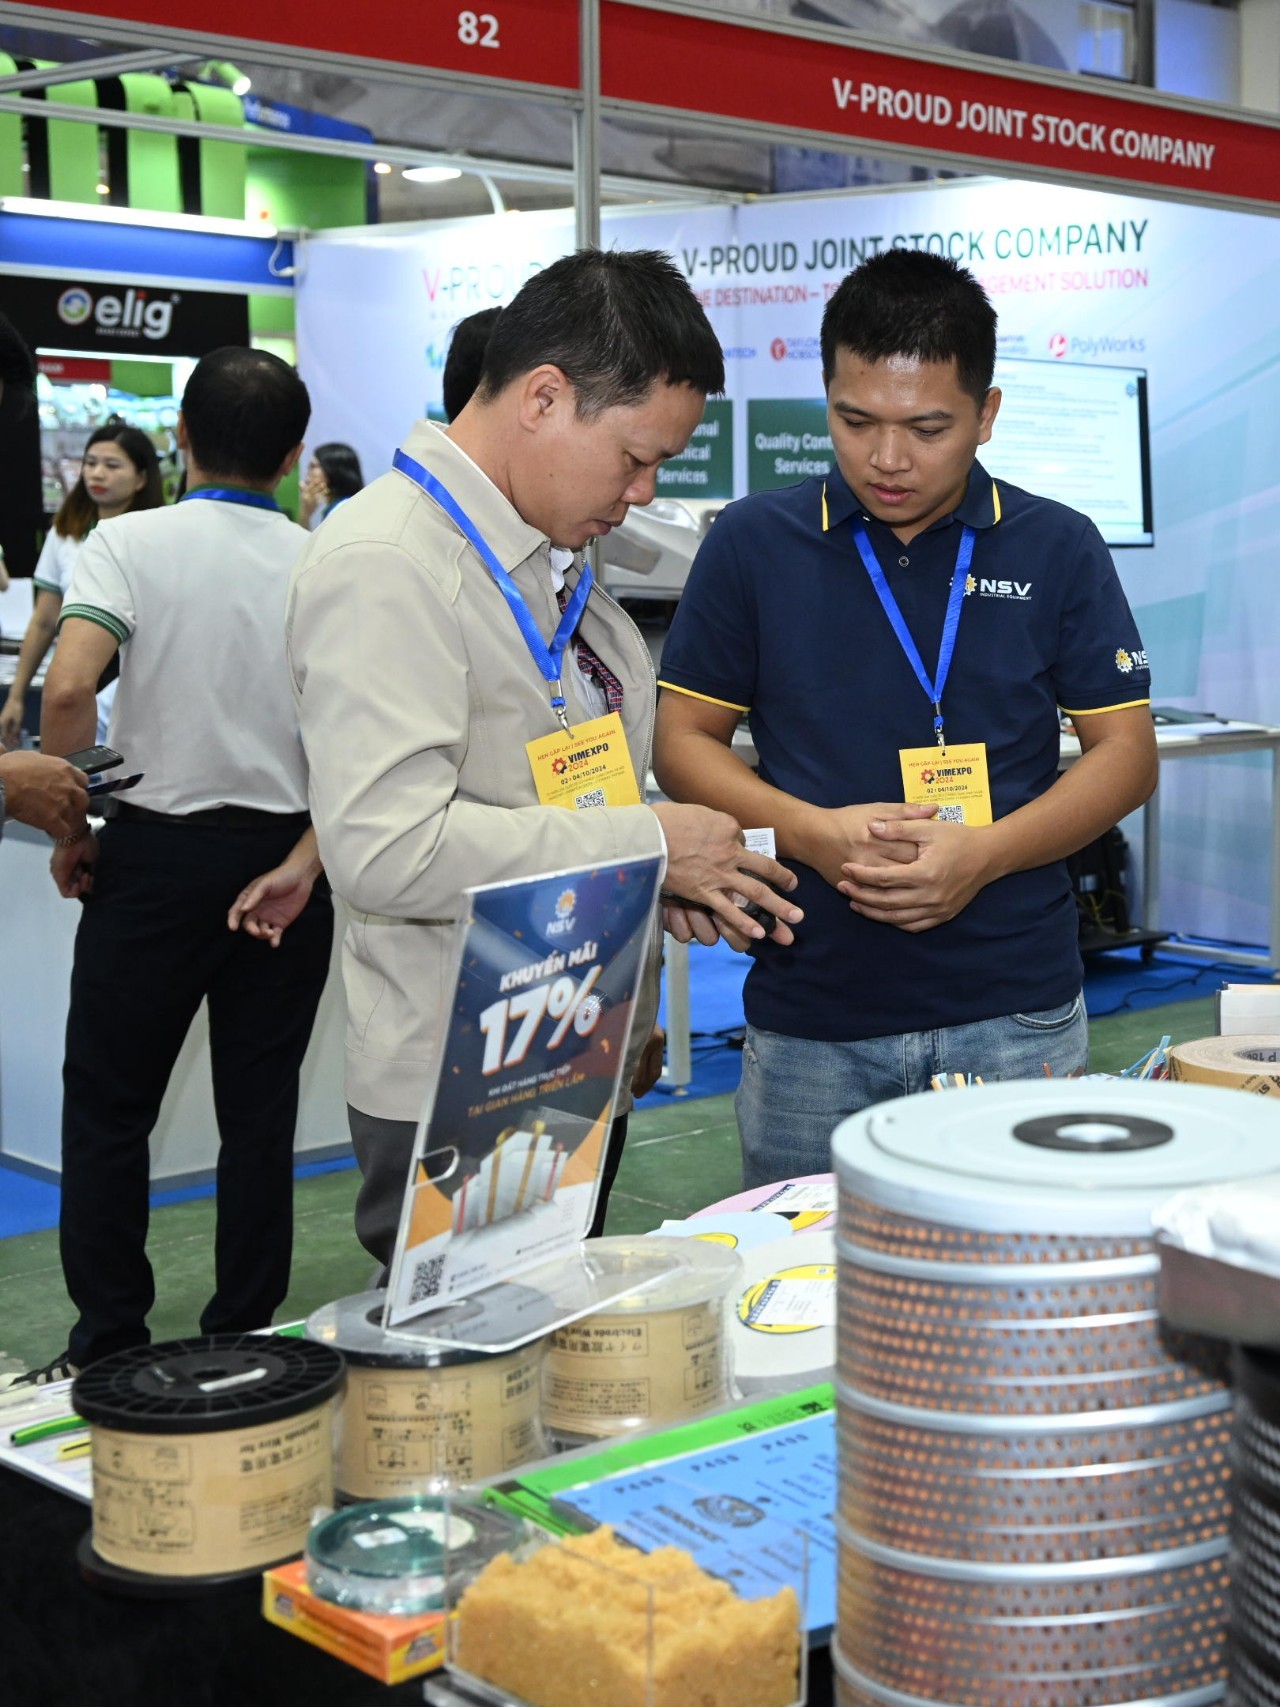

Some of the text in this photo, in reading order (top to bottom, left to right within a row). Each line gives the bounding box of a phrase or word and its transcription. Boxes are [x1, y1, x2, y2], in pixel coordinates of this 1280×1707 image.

[457, 11, 500, 49] 82
[832, 77, 1216, 172] V-PROUD JOINT STOCK COMPANY
[683, 242, 798, 277] V-PROUD
[995, 219, 1149, 260] COMPANY
[1061, 268, 1149, 291] SOLUTION
[714, 284, 808, 308] DESTINATION
[94, 288, 174, 340] elig
[1071, 335, 1146, 357] PolyWorks
[754, 432, 800, 453] Quality
[656, 467, 708, 485] Services
[774, 457, 831, 475] Services
[980, 578, 1033, 597] NSV
[567, 742, 609, 763] VIMEXPO
[560, 764, 606, 785] 02 04/10/2024
[567, 759, 588, 771] 2024
[936, 766, 972, 777] VIMEXPO
[937, 784, 967, 792] 04/10/2024
[545, 917, 576, 936] NSV
[499, 940, 599, 993] KHUYẾN MÃI
[479, 965, 603, 1077] 17%
[1268, 1052, 1276, 1062] P
[594, 1327, 642, 1338] Electrode
